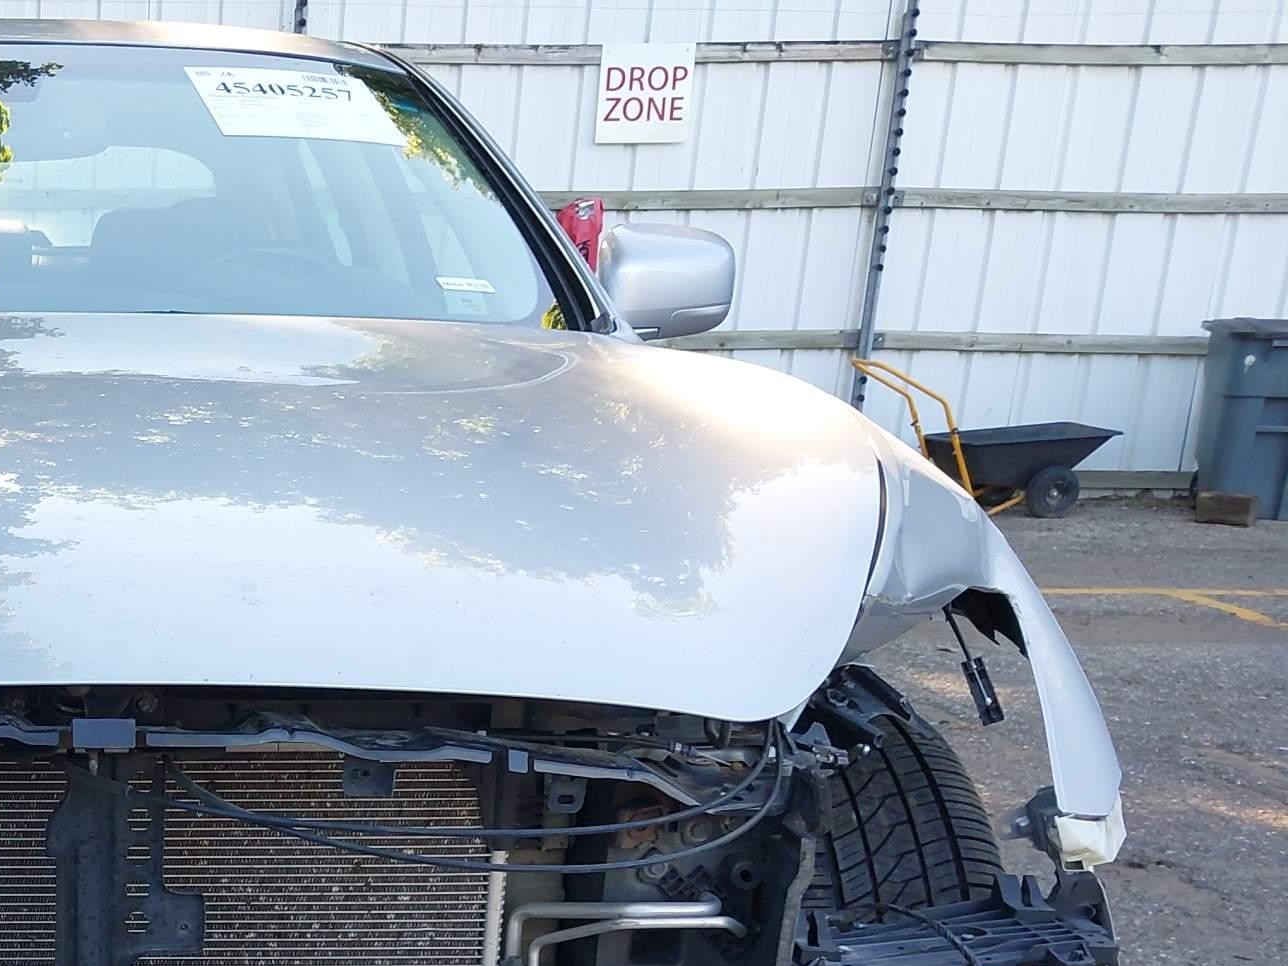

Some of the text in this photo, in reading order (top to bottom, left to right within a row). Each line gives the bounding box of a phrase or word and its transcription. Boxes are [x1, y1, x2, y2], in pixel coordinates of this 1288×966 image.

[215, 81, 352, 102] 45405257
[605, 66, 689, 92] DROP
[603, 96, 684, 122] ZONE
